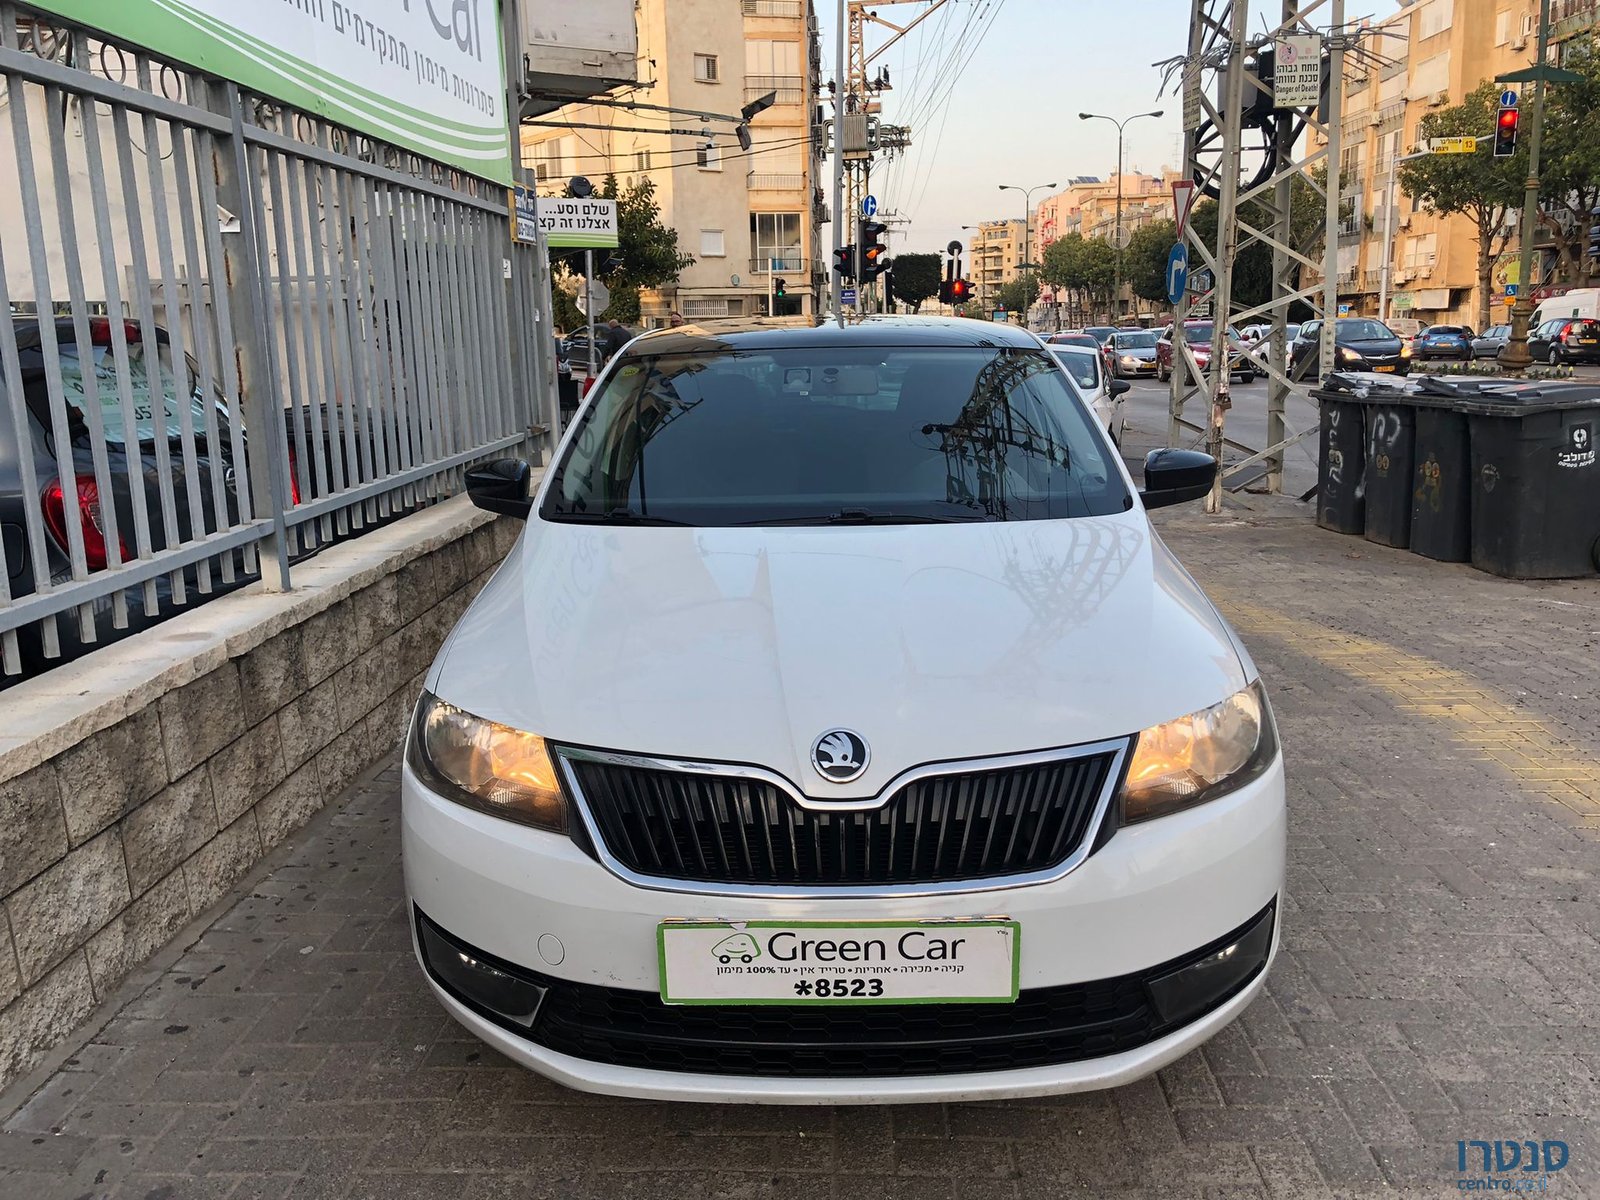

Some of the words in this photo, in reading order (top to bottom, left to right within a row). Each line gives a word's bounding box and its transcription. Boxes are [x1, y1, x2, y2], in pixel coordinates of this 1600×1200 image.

[332, 1, 410, 71] מתקדמים
[414, 50, 450, 93] מימון
[1276, 64, 1298, 73] גבוה!
[1301, 63, 1318, 72] מתח
[1299, 74, 1318, 83] סכנת
[1276, 85, 1294, 94] Danger
[1295, 84, 1301, 92] of
[452, 73, 495, 118] פתרונות
[1465, 140, 1473, 148] 13
[582, 202, 609, 216] שלם
[560, 218, 574, 228] זה
[576, 216, 610, 229] אצלנו
[768, 931, 885, 962] Green
[898, 930, 965, 961] Car
[716, 966, 743, 976] מימון
[746, 966, 776, 974] 100%
[778, 966, 791, 975] עד
[800, 966, 815, 975] אין
[818, 966, 846, 974] טרייד
[854, 965, 891, 974] אחריות
[900, 965, 932, 973] מכירה
[941, 964, 964, 974] קניה
